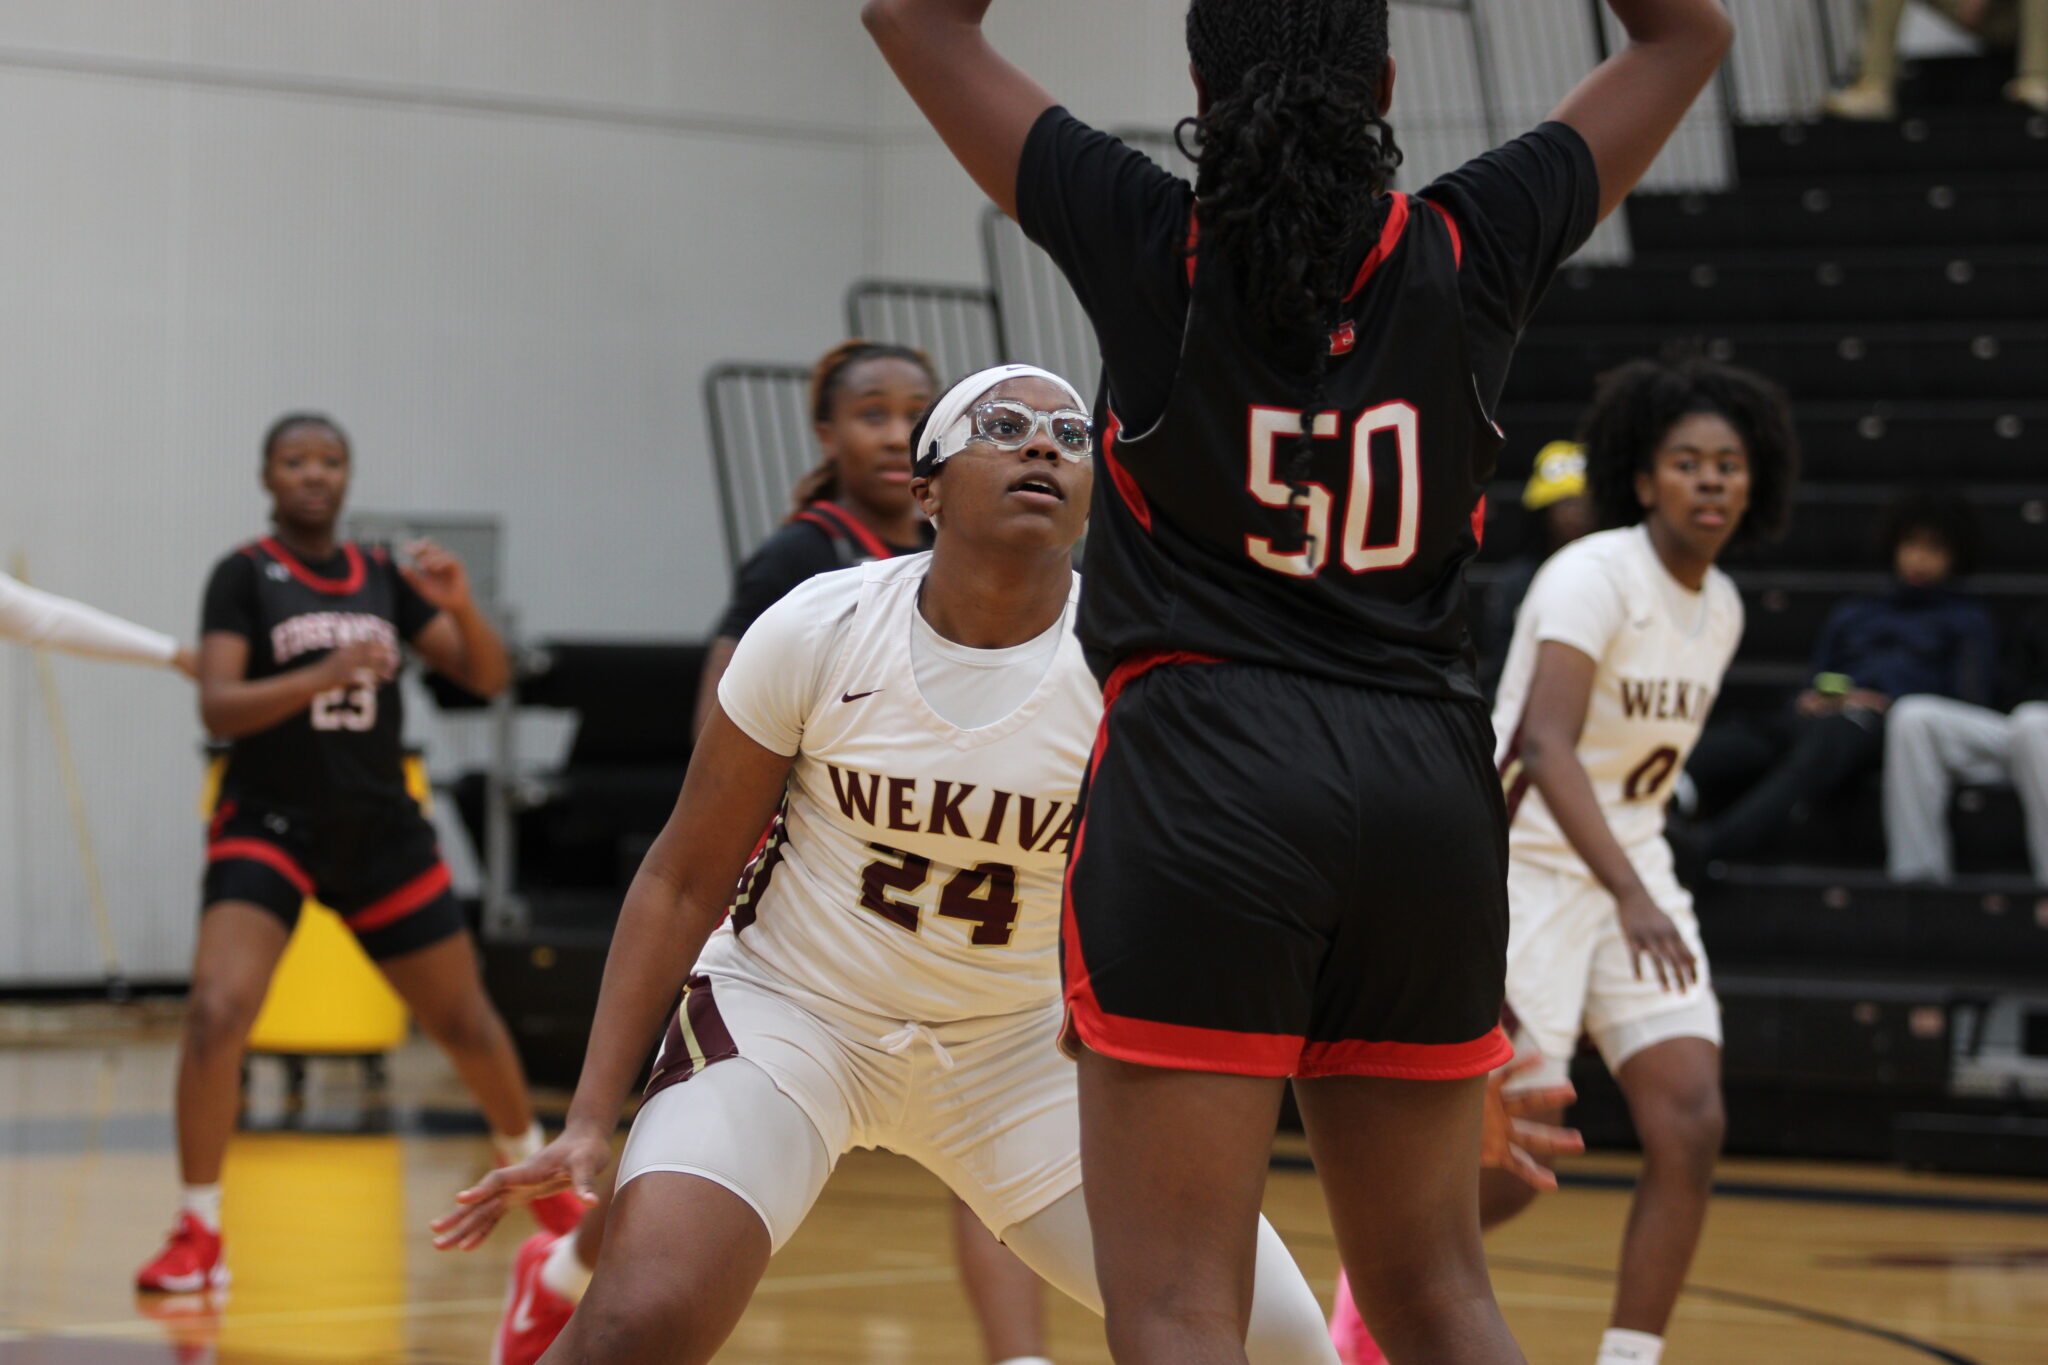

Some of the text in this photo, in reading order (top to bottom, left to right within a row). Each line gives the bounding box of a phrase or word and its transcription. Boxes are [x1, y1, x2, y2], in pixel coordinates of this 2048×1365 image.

[1244, 398, 1421, 579] 50
[826, 763, 1078, 855] WEKIVA
[1622, 744, 1679, 803] 0
[857, 840, 1023, 950] 24
